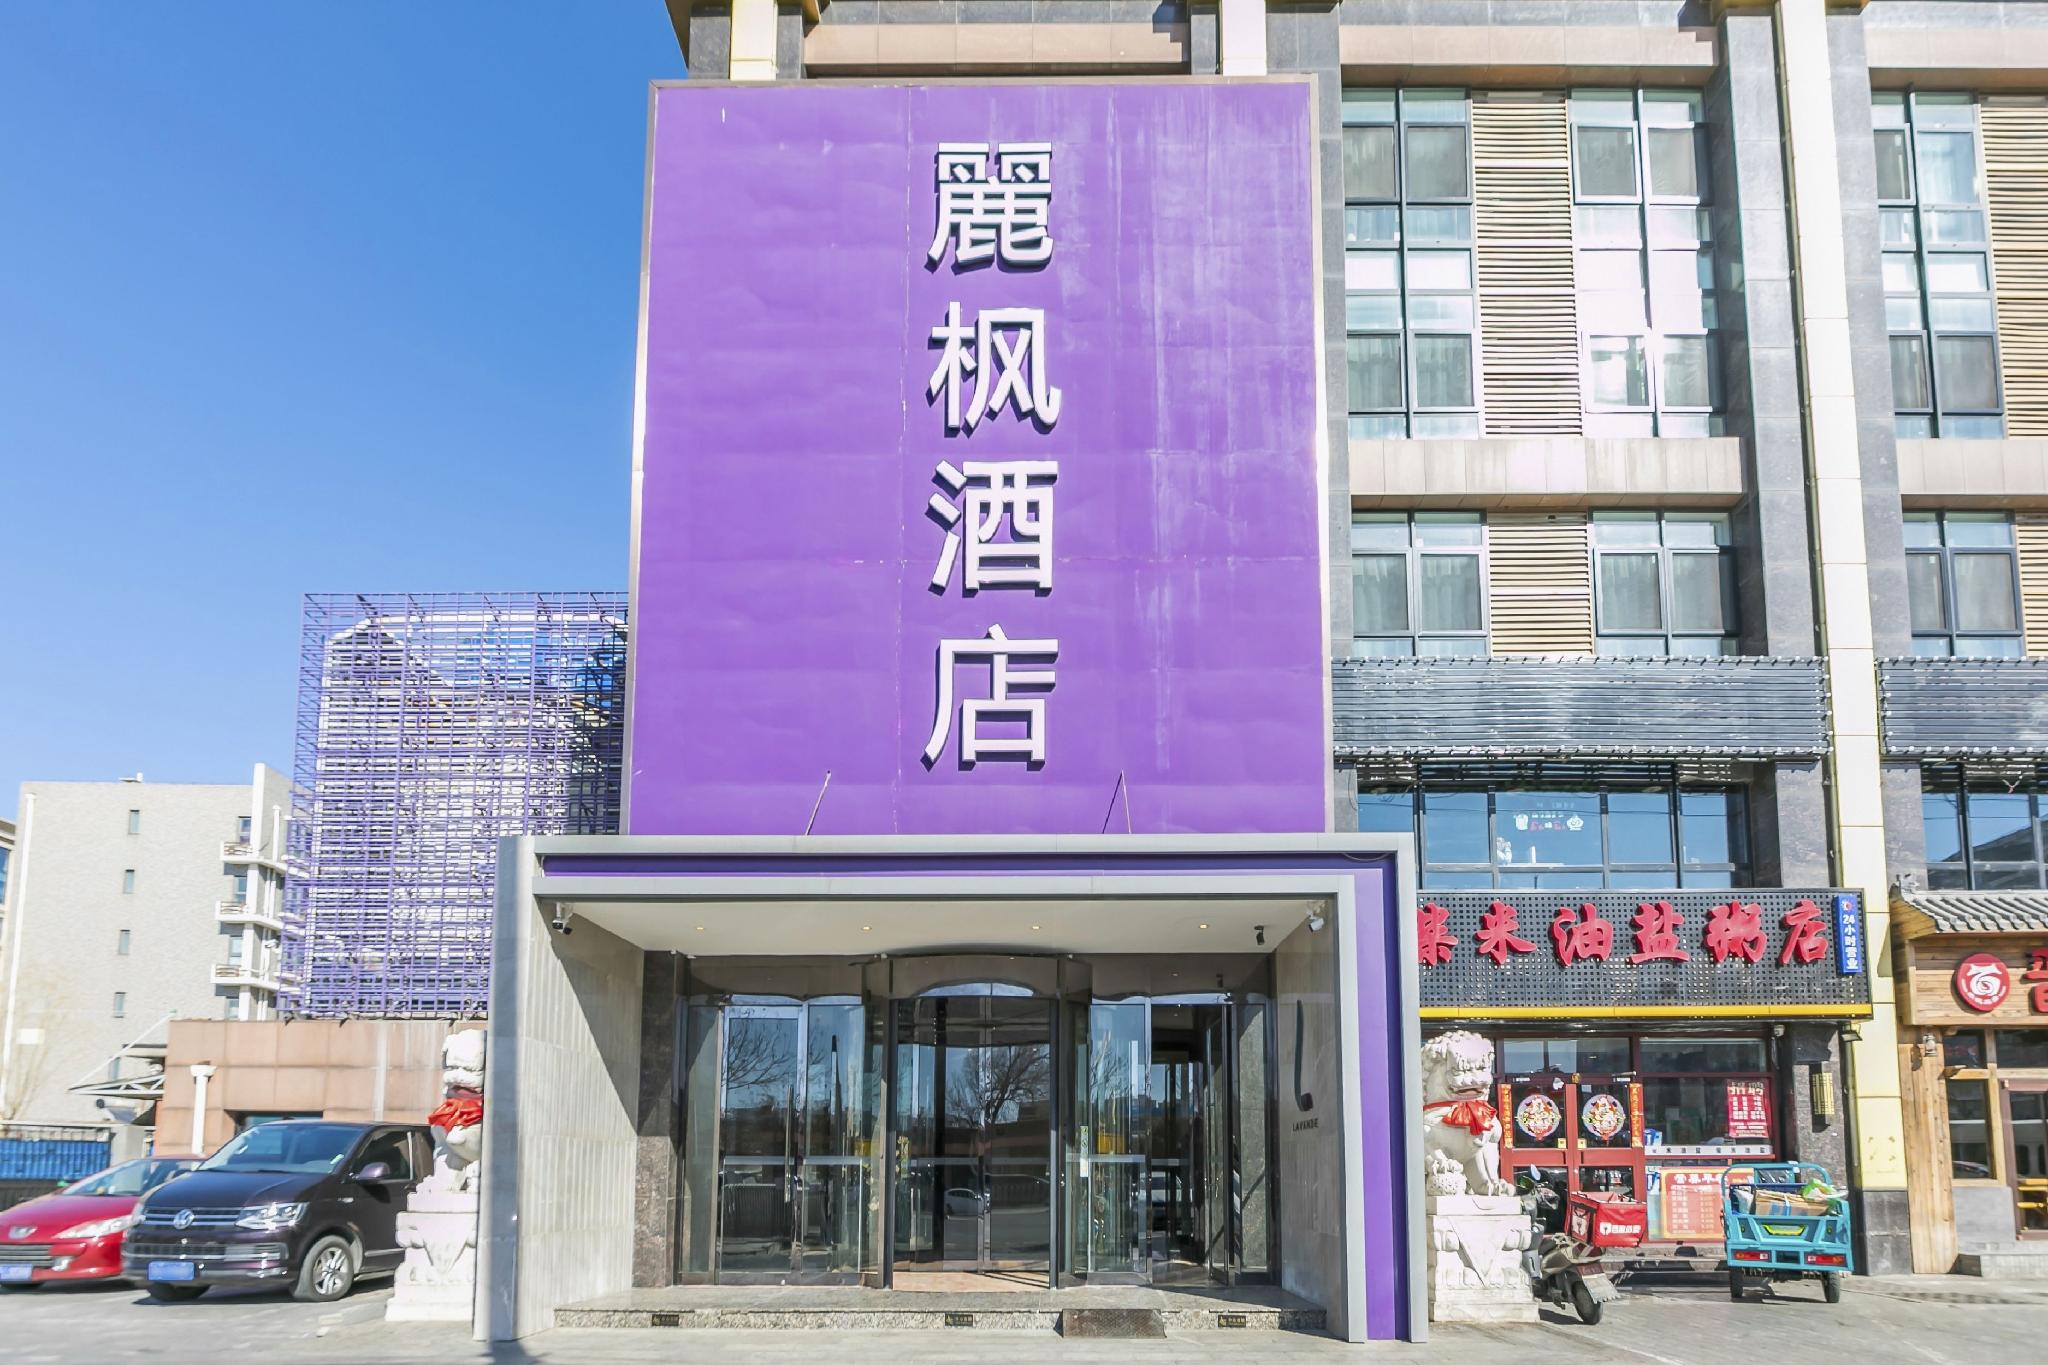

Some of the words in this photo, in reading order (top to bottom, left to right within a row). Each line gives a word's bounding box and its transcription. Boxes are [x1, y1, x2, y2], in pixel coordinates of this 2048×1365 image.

[924, 141, 1061, 765] 麗枫酒店
[1843, 914, 1859, 970] 24小时营业
